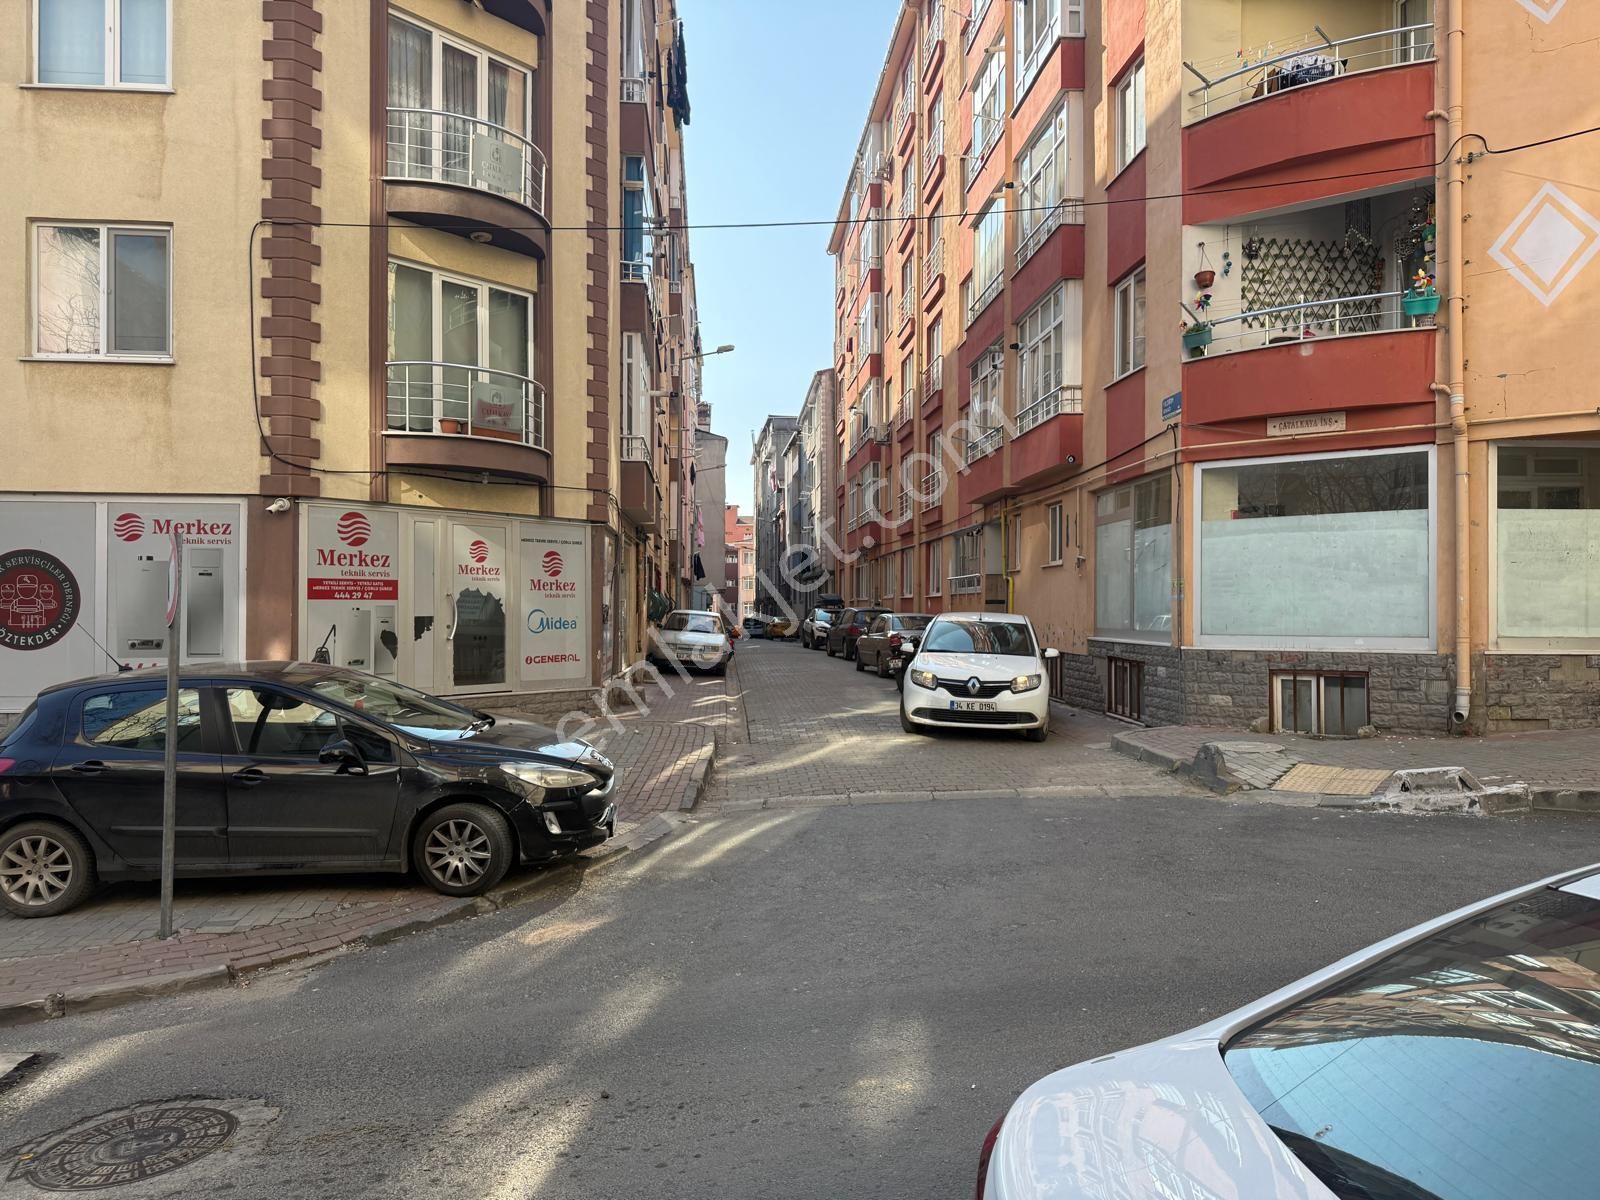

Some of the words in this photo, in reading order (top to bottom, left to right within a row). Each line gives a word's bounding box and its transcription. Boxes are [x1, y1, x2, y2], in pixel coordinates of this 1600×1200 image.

[151, 519, 232, 535] Merkez
[316, 548, 391, 568] Merkez
[340, 569, 366, 577] teknik
[458, 564, 501, 575] Merkez
[530, 579, 576, 591] Merkez
[334, 591, 350, 599] 444
[528, 609, 577, 634] Midea
[955, 702, 963, 710] 34
[966, 702, 976, 710] KE
